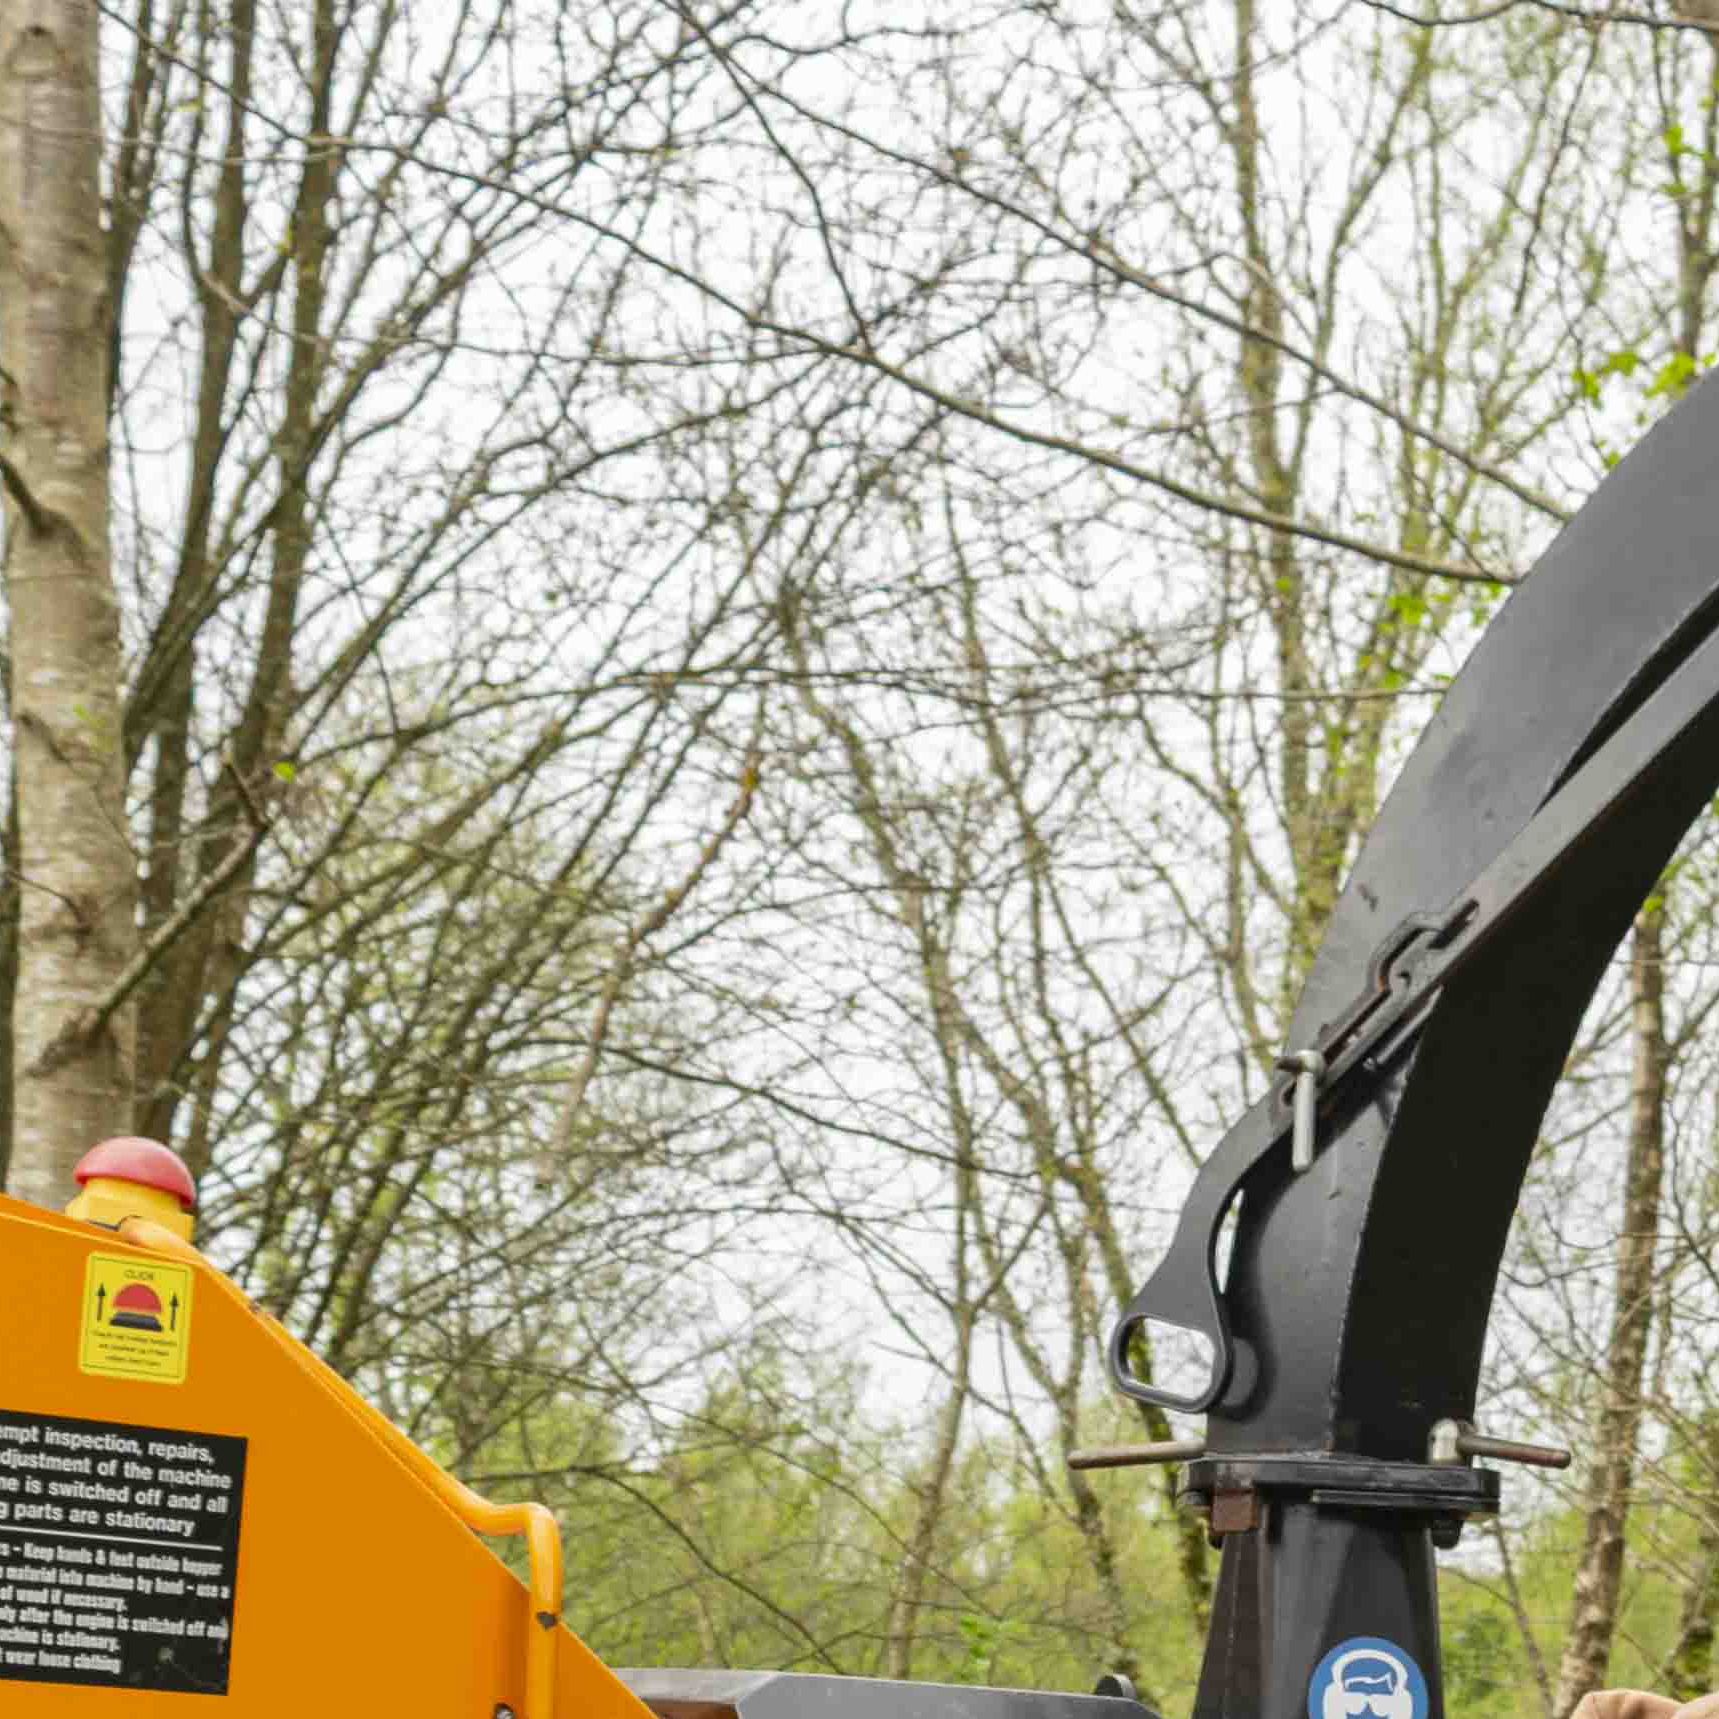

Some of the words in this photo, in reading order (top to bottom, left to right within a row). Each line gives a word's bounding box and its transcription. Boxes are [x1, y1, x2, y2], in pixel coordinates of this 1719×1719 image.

[45, 1425, 143, 1456] inspection,
[148, 1441, 215, 1465] repairs,
[97, 1459, 118, 1476] of
[123, 1461, 153, 1481] the
[158, 1467, 233, 1489] machine
[25, 1475, 43, 1495] is
[48, 1480, 130, 1503] switched
[134, 1489, 164, 1506] off
[167, 1493, 202, 1511] and
[206, 1496, 229, 1514] all
[14, 1503, 63, 1521] parts
[68, 1508, 100, 1525] are
[105, 1511, 196, 1537] stationary
